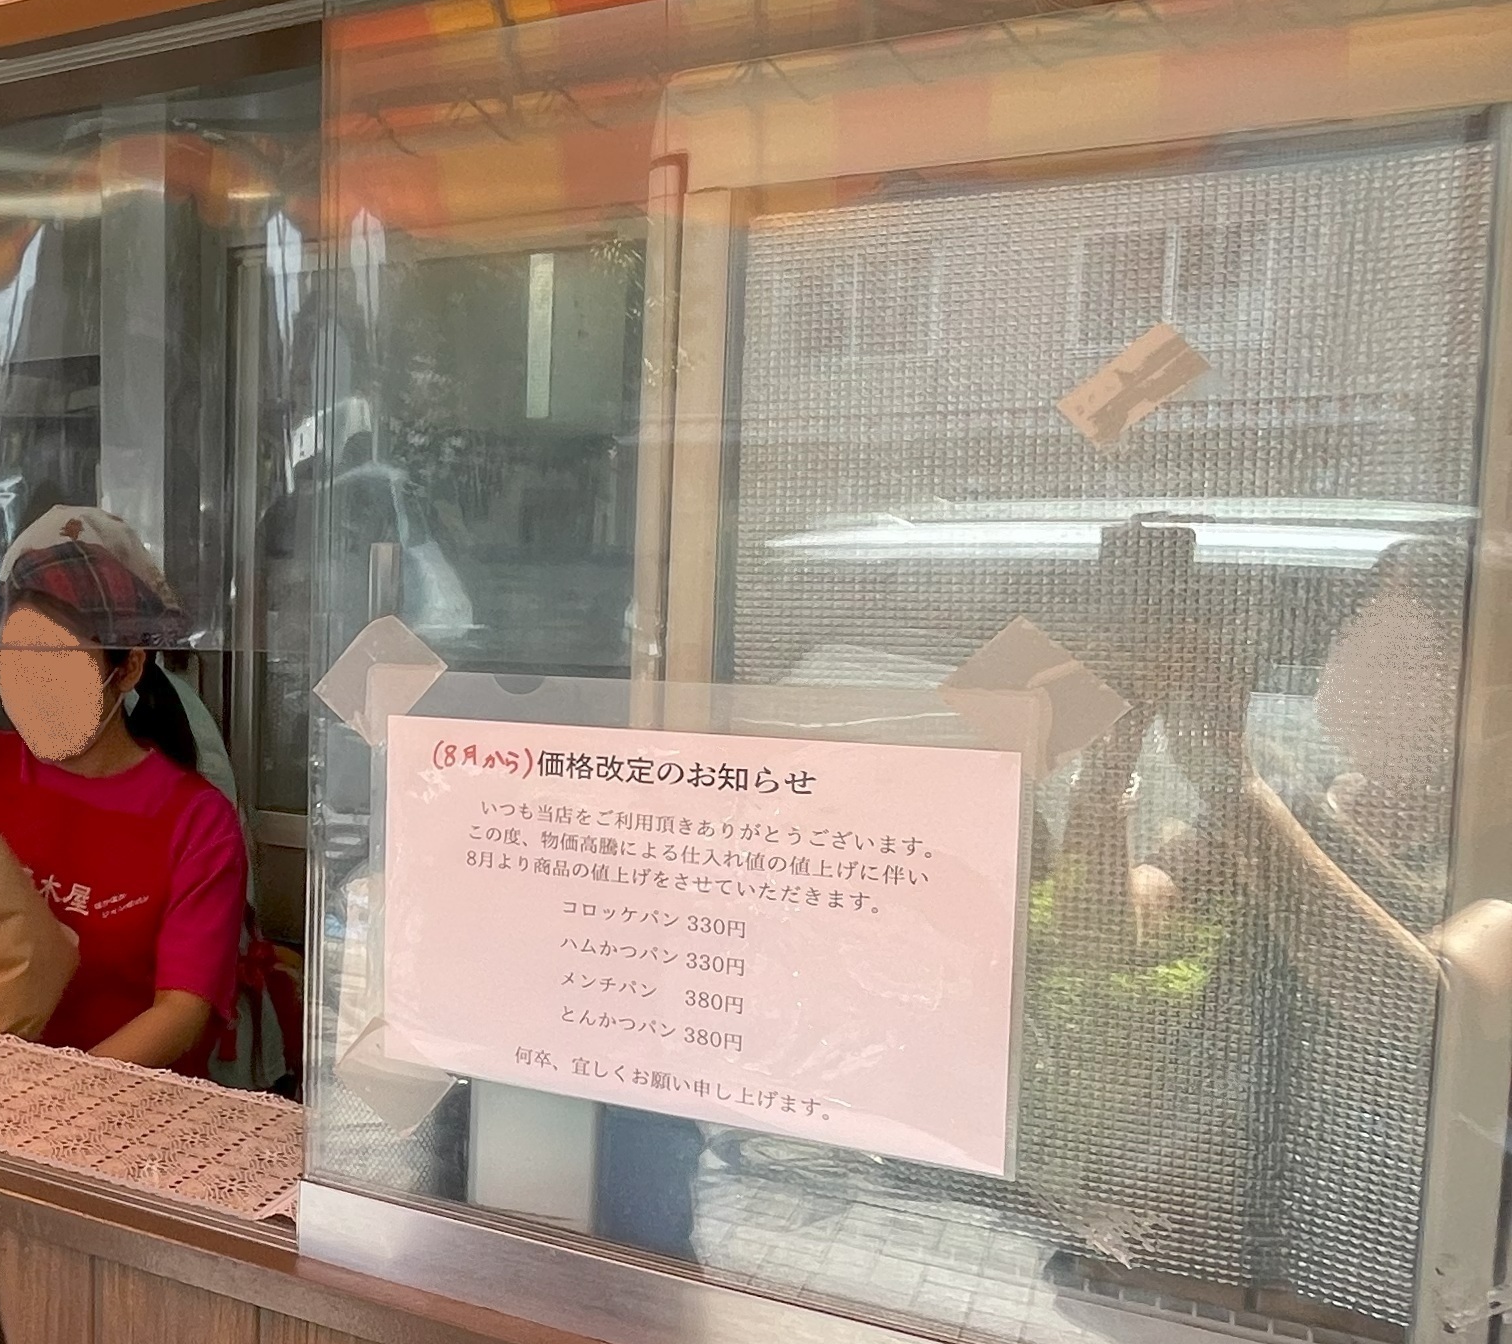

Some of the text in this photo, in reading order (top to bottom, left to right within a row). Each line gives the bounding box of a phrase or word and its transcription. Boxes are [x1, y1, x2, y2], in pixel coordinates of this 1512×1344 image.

[537, 750, 817, 795] 価格改定のお知らせ
[481, 800, 933, 859] いつも当店をご利用頂きありがとうございます。
[468, 826, 929, 886] この度、物価高騰による仕入れ値の値上げに伴い
[26, 868, 91, 916] 木屋
[466, 851, 881, 914] 8月より商品の値上げをさせていただきます。
[562, 900, 746, 939] コロッケパン 330円
[560, 937, 745, 977] ハムかつパン 330円
[560, 972, 744, 1015] メンチパン 380円
[561, 1006, 743, 1052] とんかつパン 380円
[515, 1046, 830, 1121] 何卒、宜しくお願い申し上げます。
